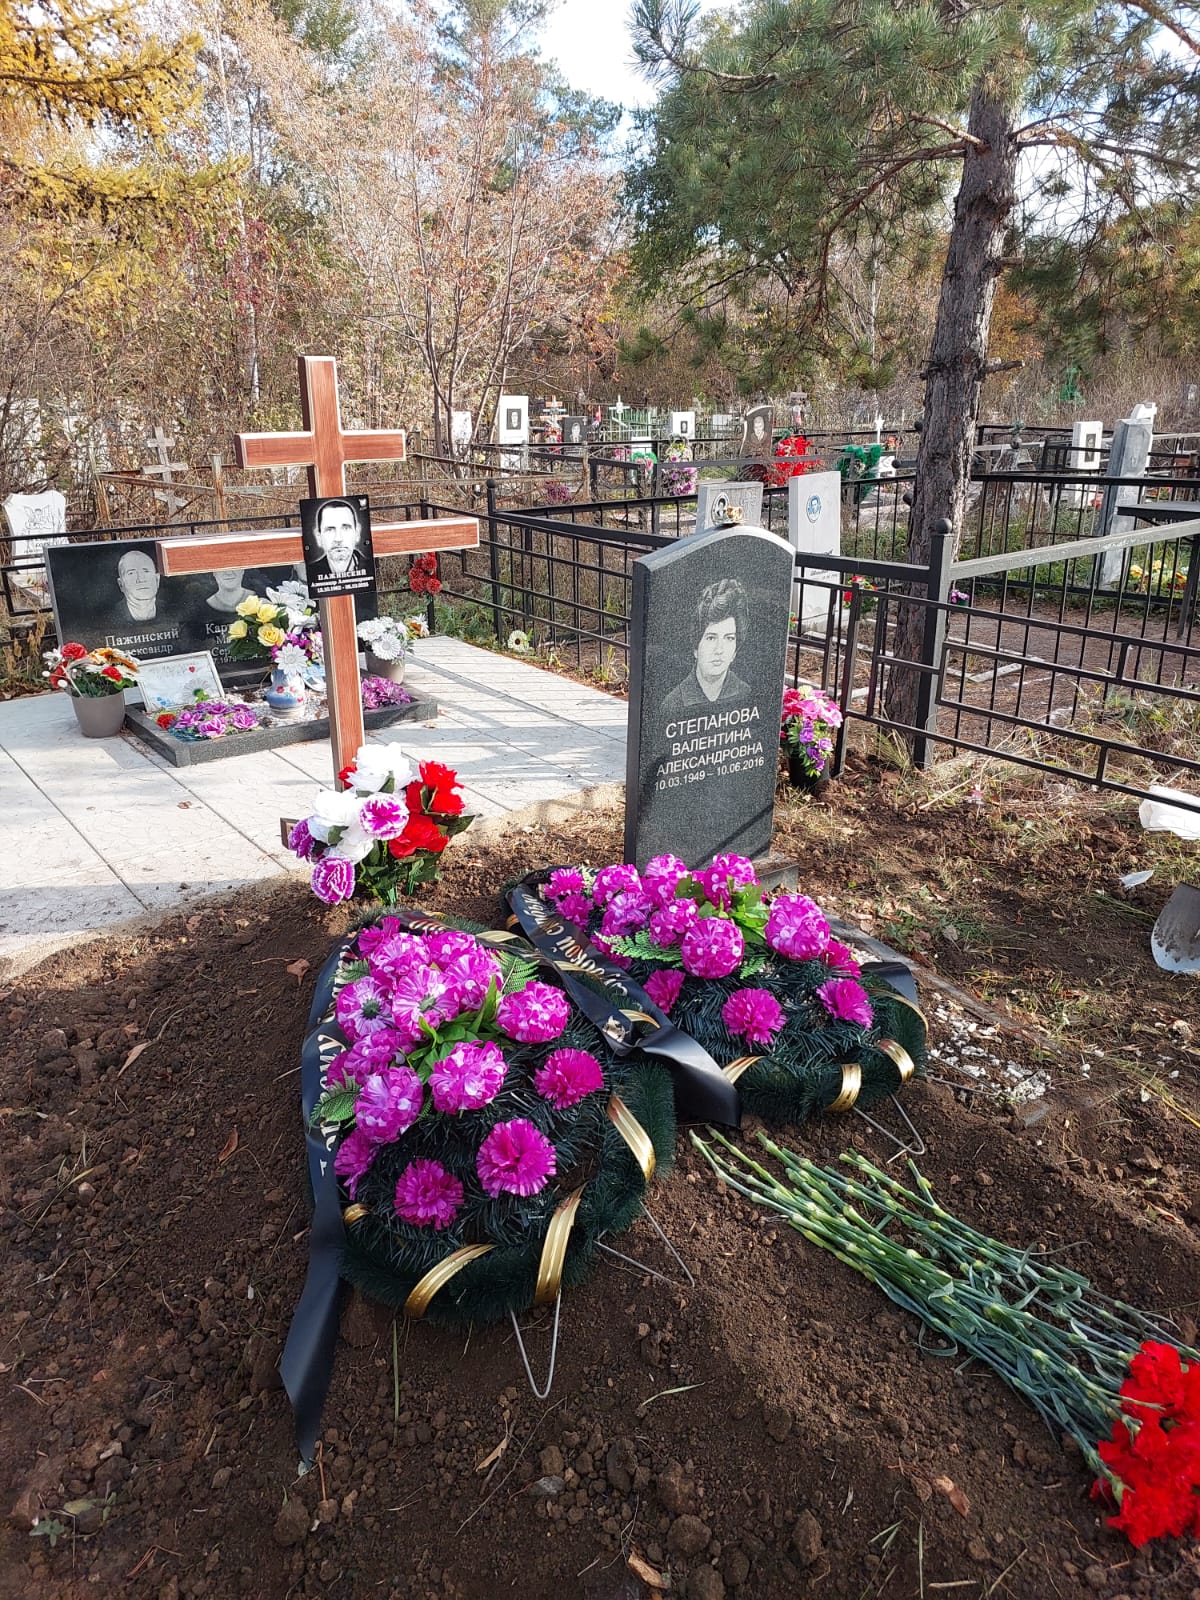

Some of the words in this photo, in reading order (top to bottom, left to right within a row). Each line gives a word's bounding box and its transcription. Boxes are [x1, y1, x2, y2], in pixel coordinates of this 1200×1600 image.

[317, 569, 367, 581] ПАЖИНСКИЙ
[104, 627, 179, 647] Пажинский
[665, 706, 760, 739] СТЕПАНОВА
[672, 727, 752, 756] ВАЛЕНТИНА
[654, 770, 706, 791] 10.03.1949
[716, 756, 765, 777] 10.06.2016
[656, 742, 763, 777] АЛЕКСАНДРОВНА
